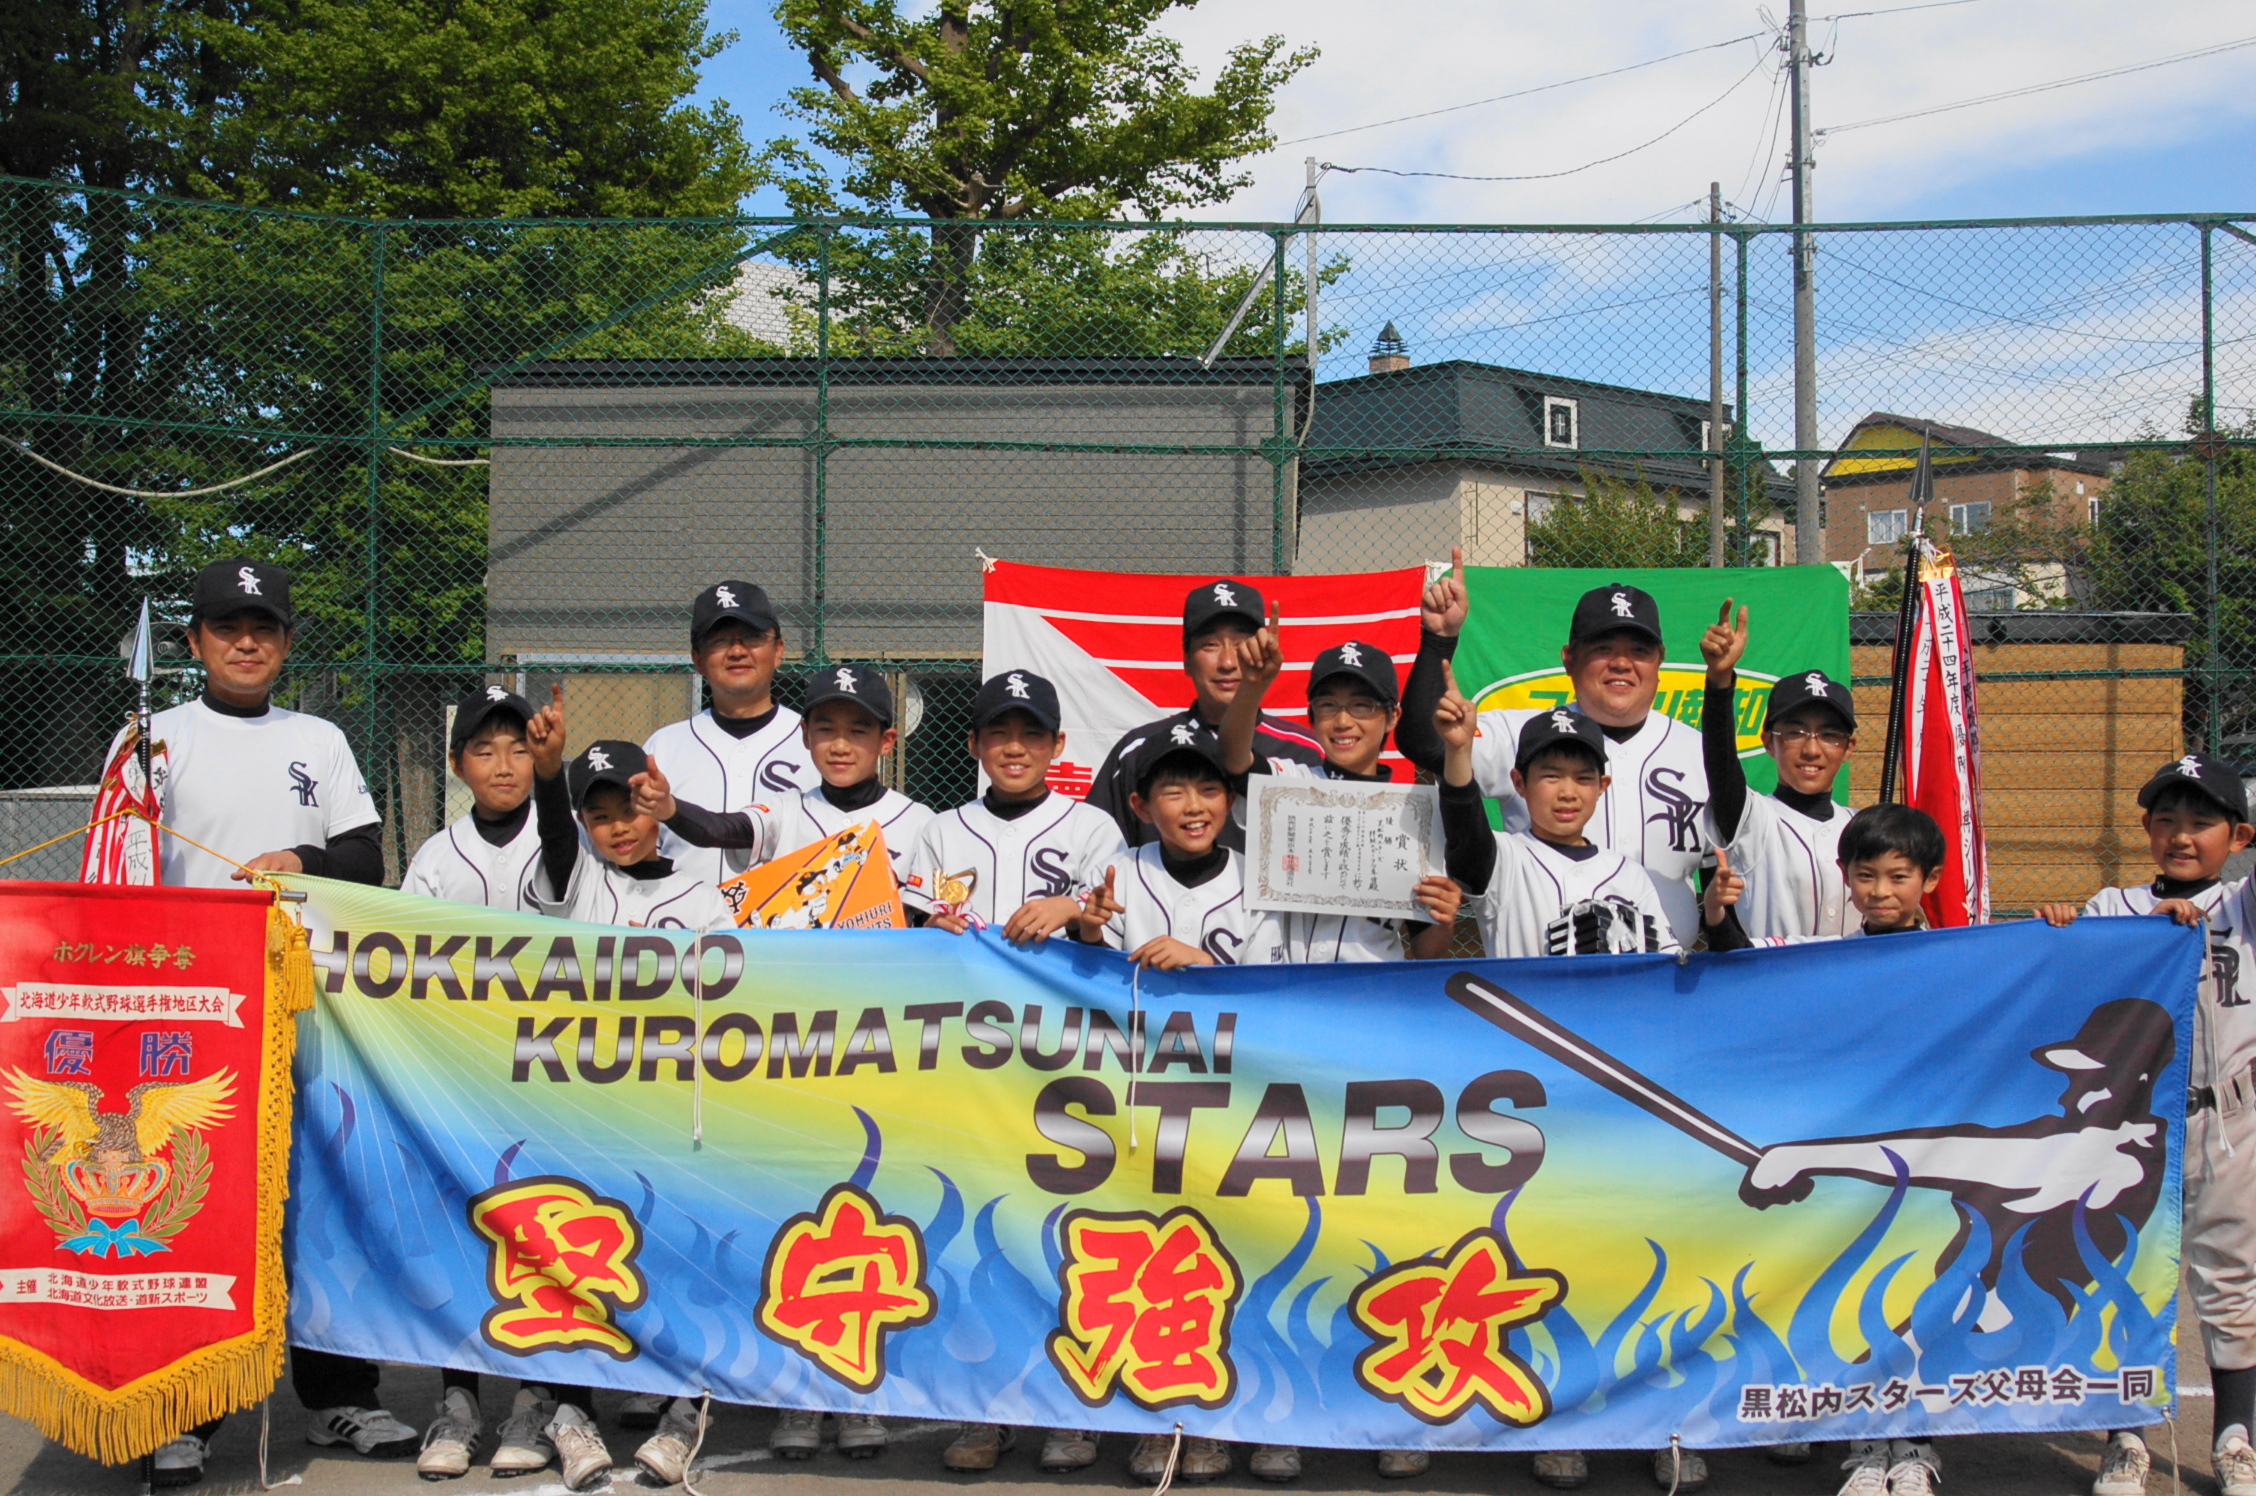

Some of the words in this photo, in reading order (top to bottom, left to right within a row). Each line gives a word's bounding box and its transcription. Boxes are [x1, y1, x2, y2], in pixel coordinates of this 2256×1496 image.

[53, 940, 198, 970] ホクレン旗争奪
[308, 929, 745, 1001] HOKKAIDO
[20, 991, 225, 1014] 北海道少年軟式野球選手権地区大会
[44, 1029, 193, 1077] 優勝
[511, 1000, 1238, 1083] KUROMATSUNAI
[1025, 1069, 1548, 1197] STARS
[16, 1279, 37, 1294] 主催
[48, 1273, 208, 1291] 北海道少年軟式野球連盟
[1742, 1369, 2155, 1419] 黒松内スターズ父母会一同
